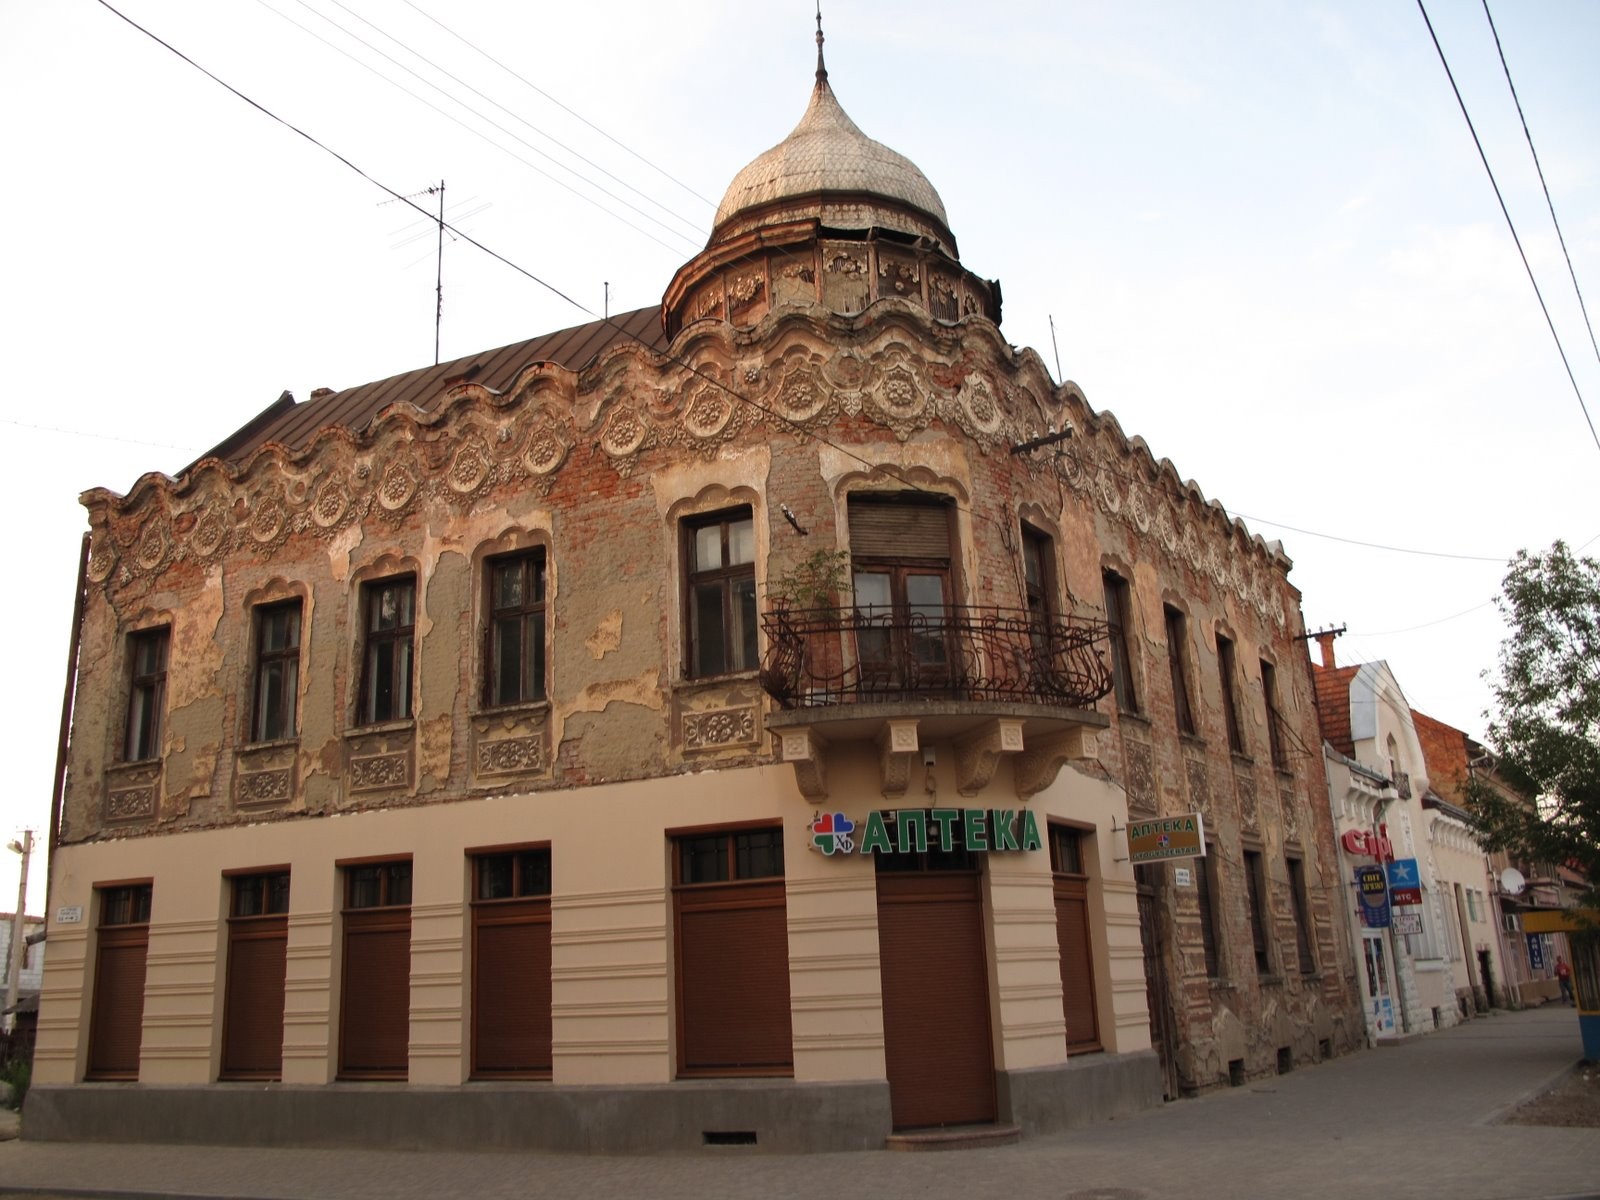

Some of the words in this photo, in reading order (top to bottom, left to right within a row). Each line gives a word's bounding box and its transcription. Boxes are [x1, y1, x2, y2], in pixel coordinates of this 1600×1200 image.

[860, 809, 1042, 854] АПТЕКА
[1131, 818, 1195, 840] АПТЕКА
[1394, 893, 1412, 901] МТС
